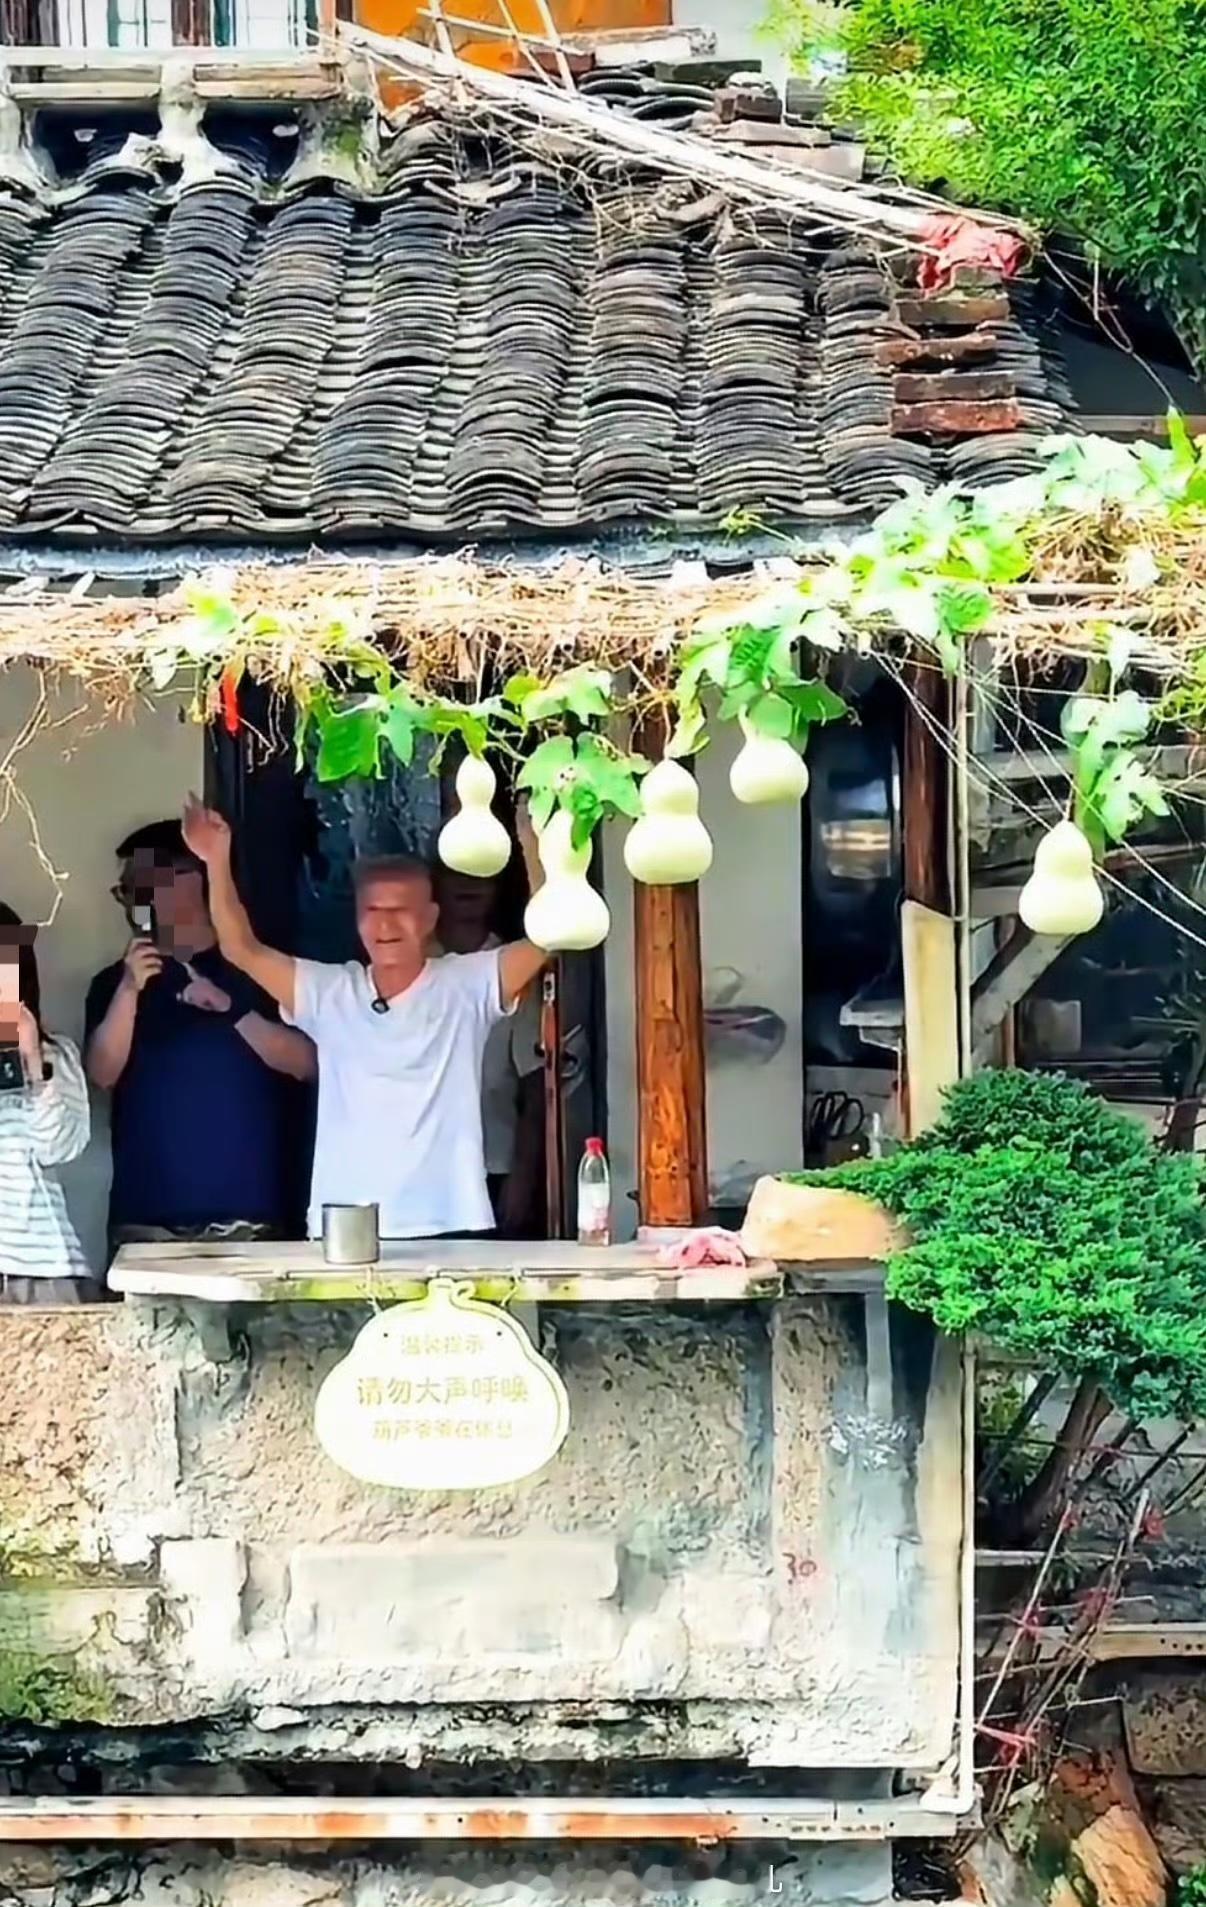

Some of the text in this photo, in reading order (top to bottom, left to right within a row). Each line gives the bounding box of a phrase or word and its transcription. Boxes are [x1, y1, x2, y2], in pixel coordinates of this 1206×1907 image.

[357, 1375, 529, 1406] 请勿大声呼唤
